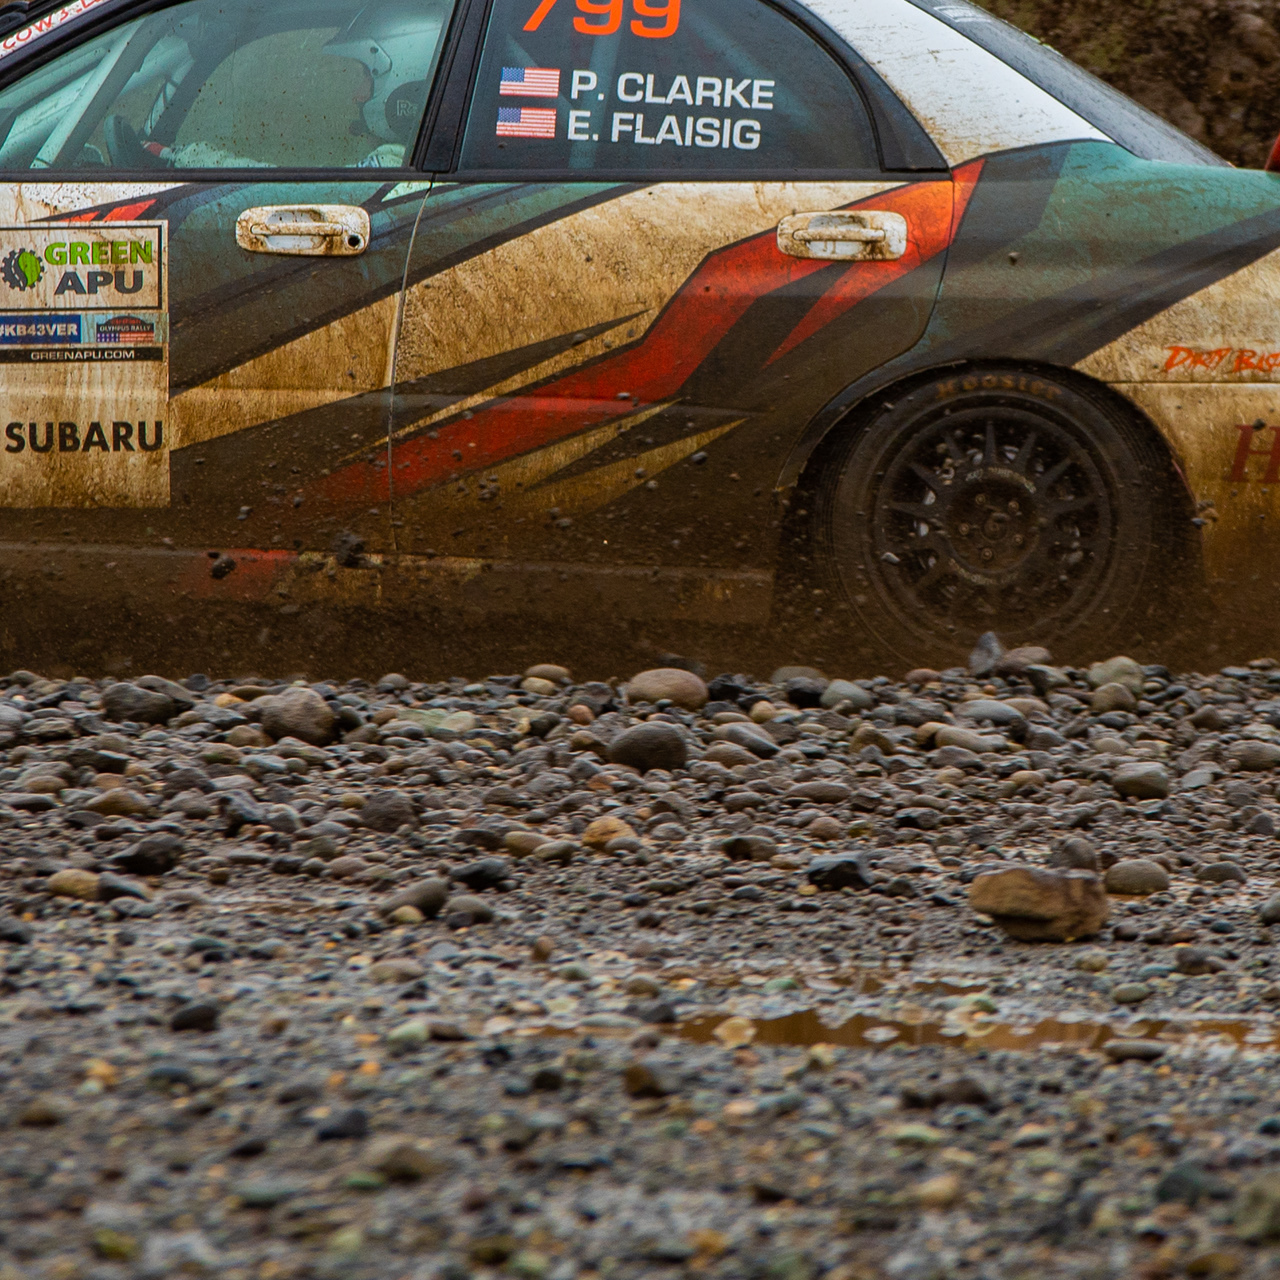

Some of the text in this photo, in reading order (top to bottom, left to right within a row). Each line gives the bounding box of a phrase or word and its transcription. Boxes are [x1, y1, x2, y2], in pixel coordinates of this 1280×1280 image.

[570, 70, 775, 110] P. CLARKE
[567, 110, 761, 151] E. FLAISIG
[44, 240, 153, 266] GREEN
[53, 270, 144, 295] APU
[30, 349, 135, 361] GREENAPU.COM
[5, 420, 163, 453] SUBARU
